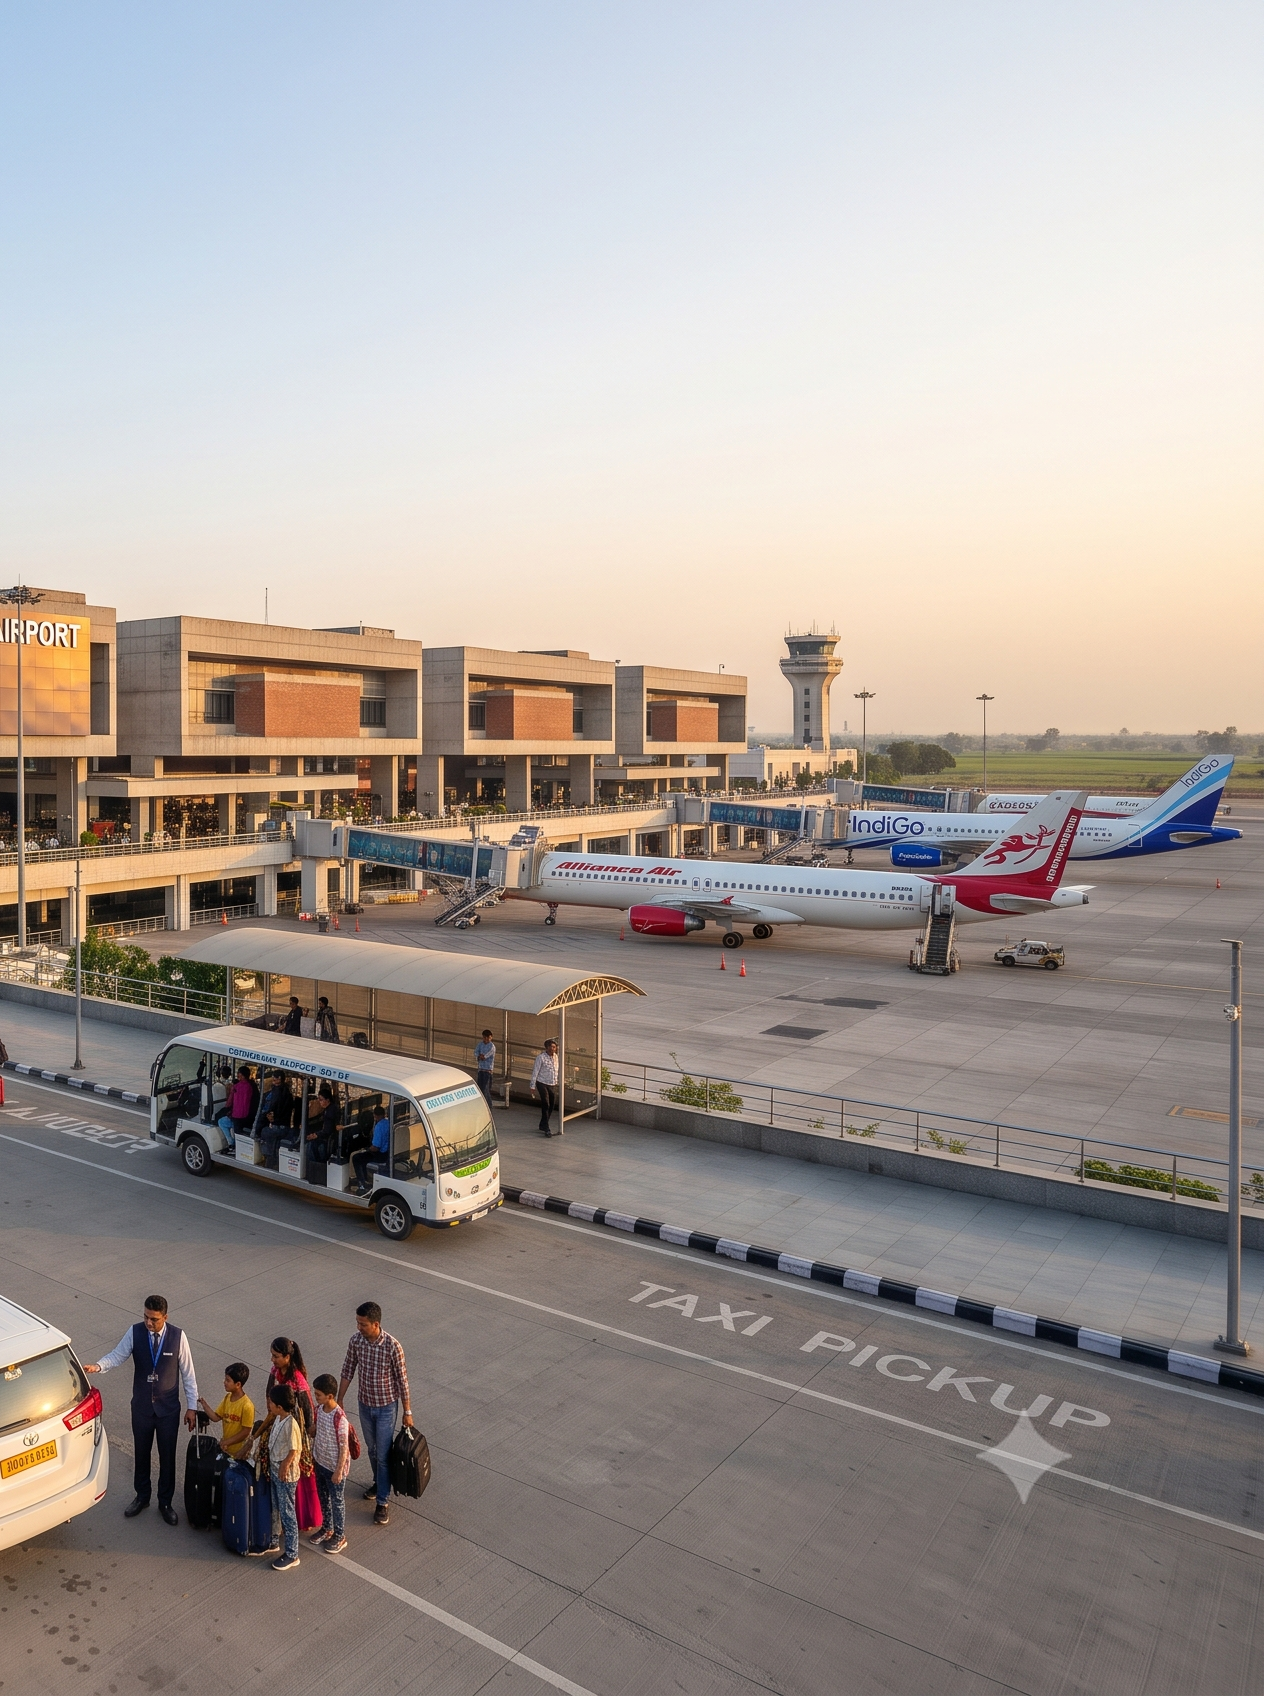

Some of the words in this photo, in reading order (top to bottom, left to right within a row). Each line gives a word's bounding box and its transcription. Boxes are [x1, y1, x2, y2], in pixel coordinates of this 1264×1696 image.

[852, 815, 925, 836] IndiGo
[555, 861, 645, 874] Alliance
[646, 866, 683, 877] Air
[627, 1280, 774, 1337] TAXI
[799, 1330, 1112, 1428] PICKUP
